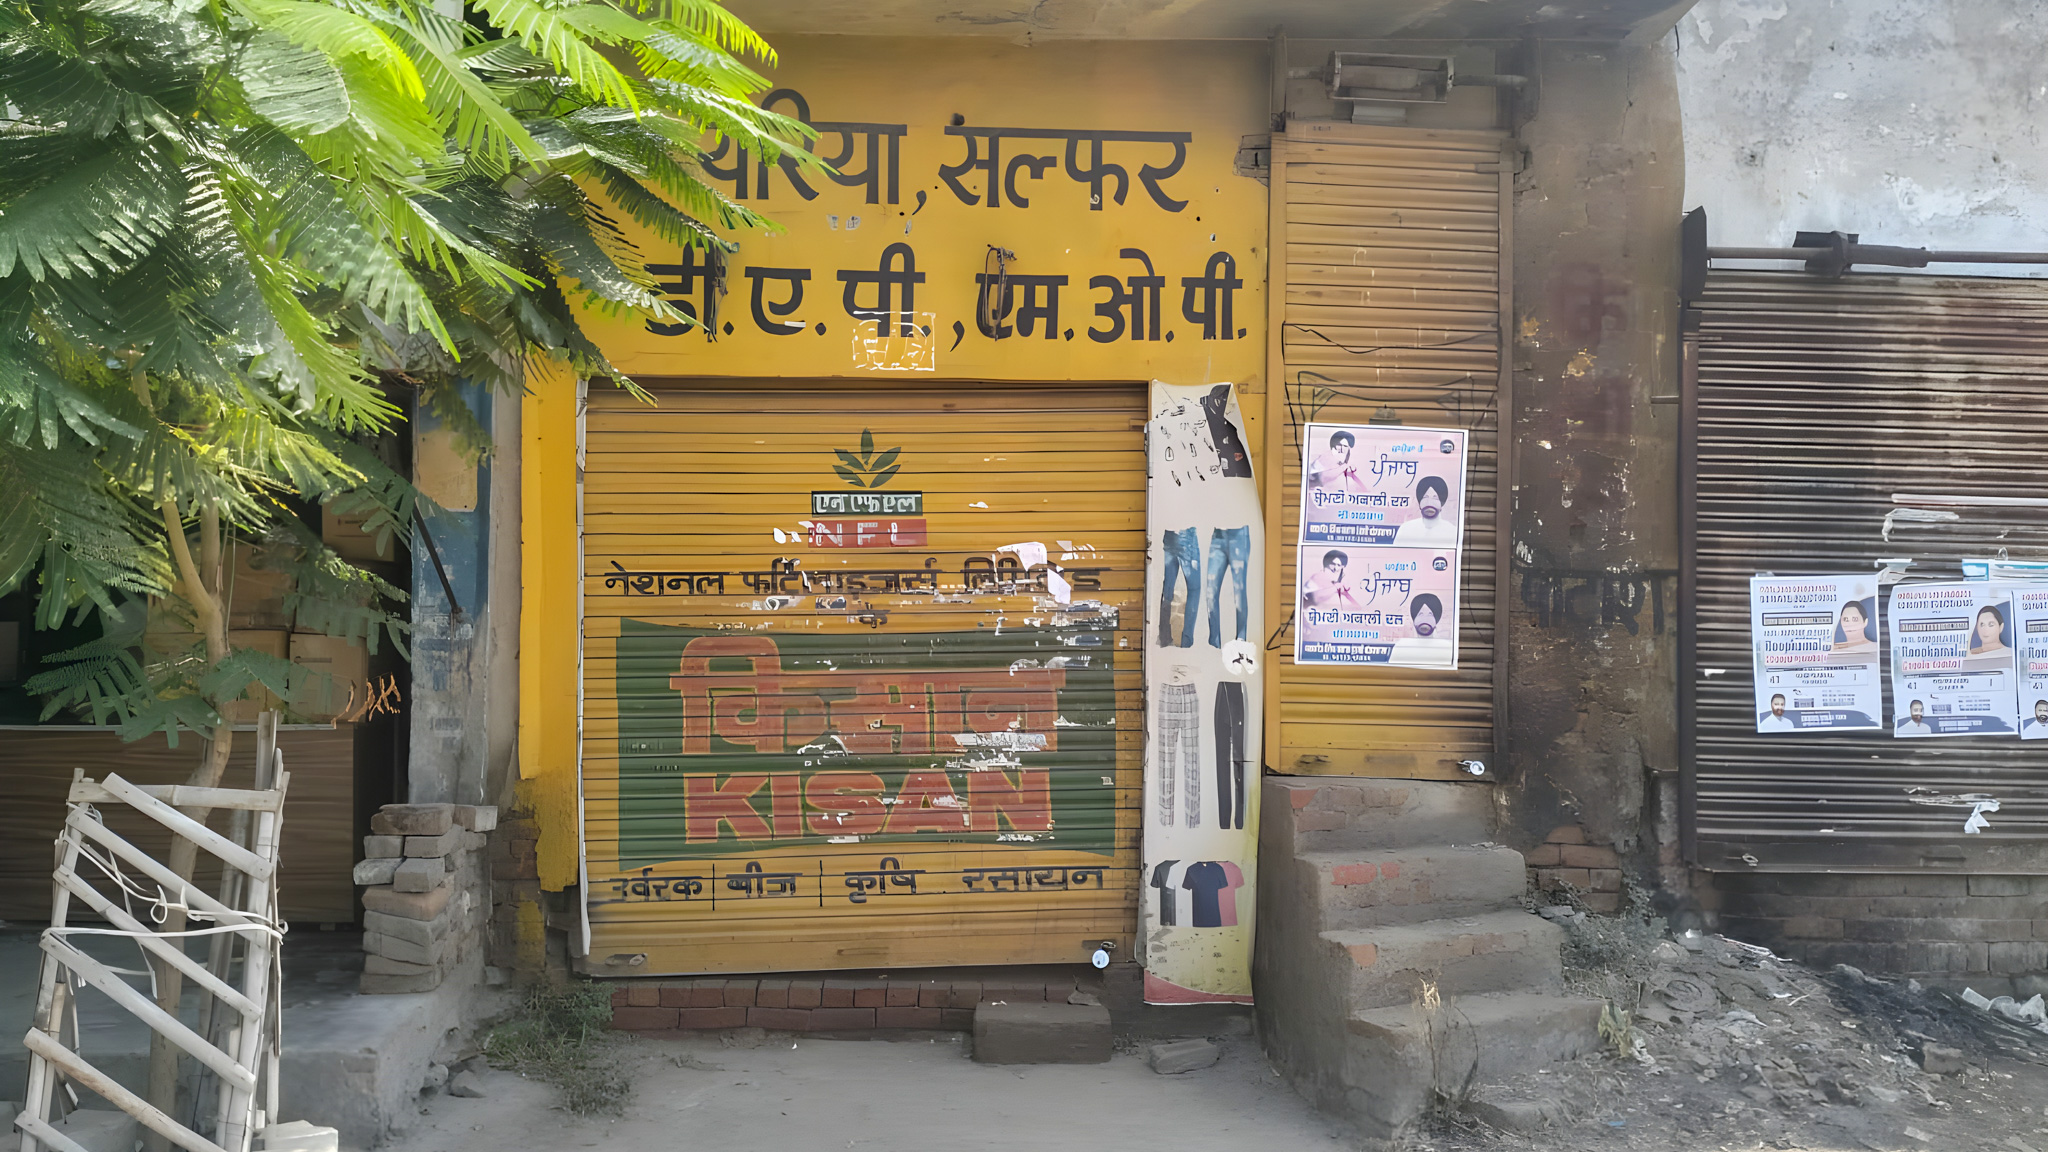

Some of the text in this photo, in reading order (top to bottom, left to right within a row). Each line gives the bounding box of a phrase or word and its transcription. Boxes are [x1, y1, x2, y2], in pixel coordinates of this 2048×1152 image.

[938, 122, 1192, 213] सल्फर
[1369, 453, 1419, 489] ਪੰਜਾਬ
[604, 560, 735, 596] नेशनल
[1361, 571, 1413, 606] ਪੰਜਾਬ
[669, 636, 1067, 755] किसान
[683, 768, 1054, 844] KISAN
